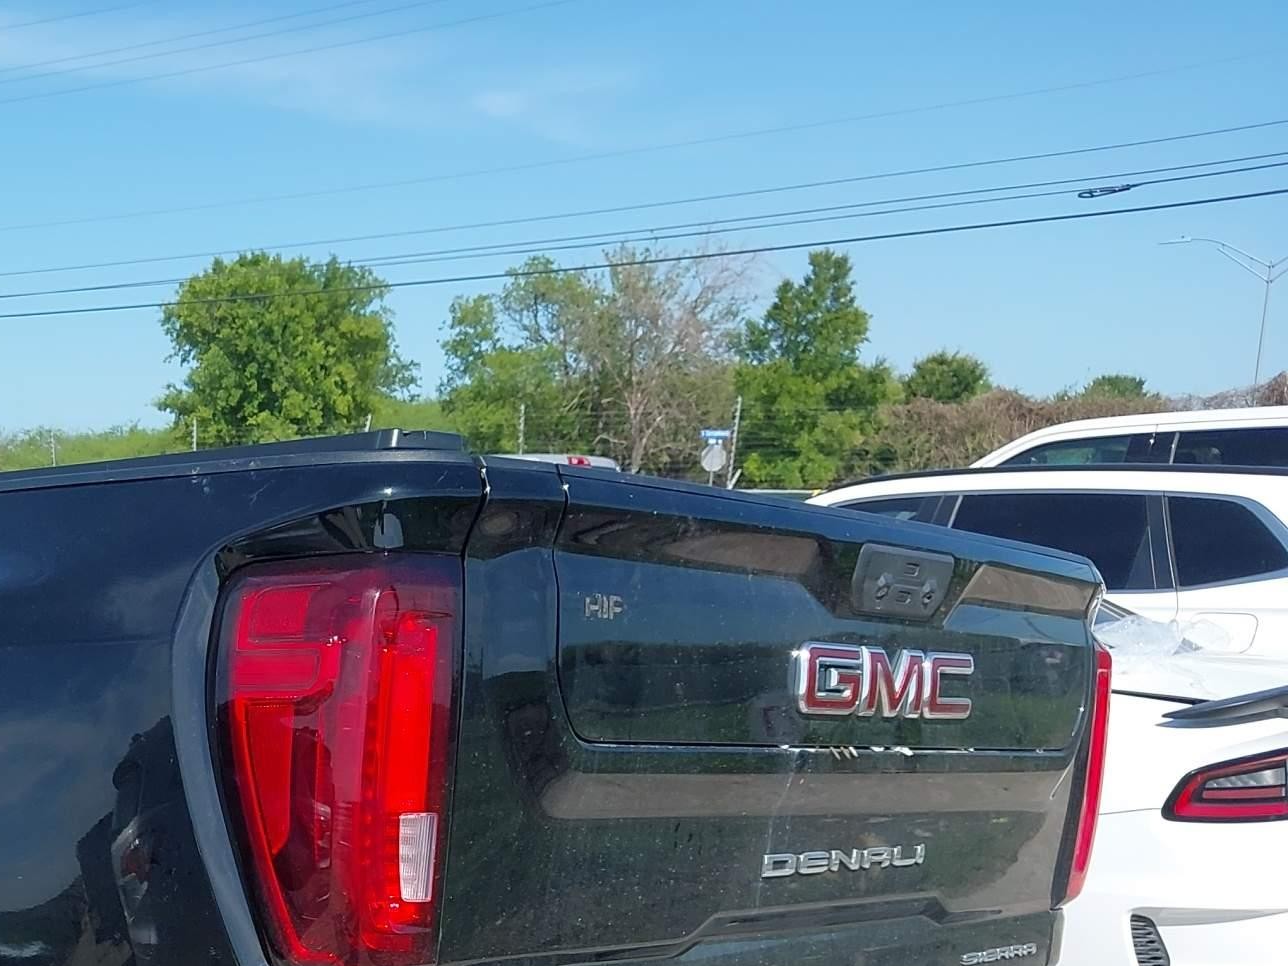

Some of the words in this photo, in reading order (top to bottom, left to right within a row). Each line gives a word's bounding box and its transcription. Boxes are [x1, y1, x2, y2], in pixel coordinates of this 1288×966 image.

[795, 641, 975, 720] GMC
[762, 843, 926, 878] DENALI
[959, 943, 1037, 966] SIERRA
